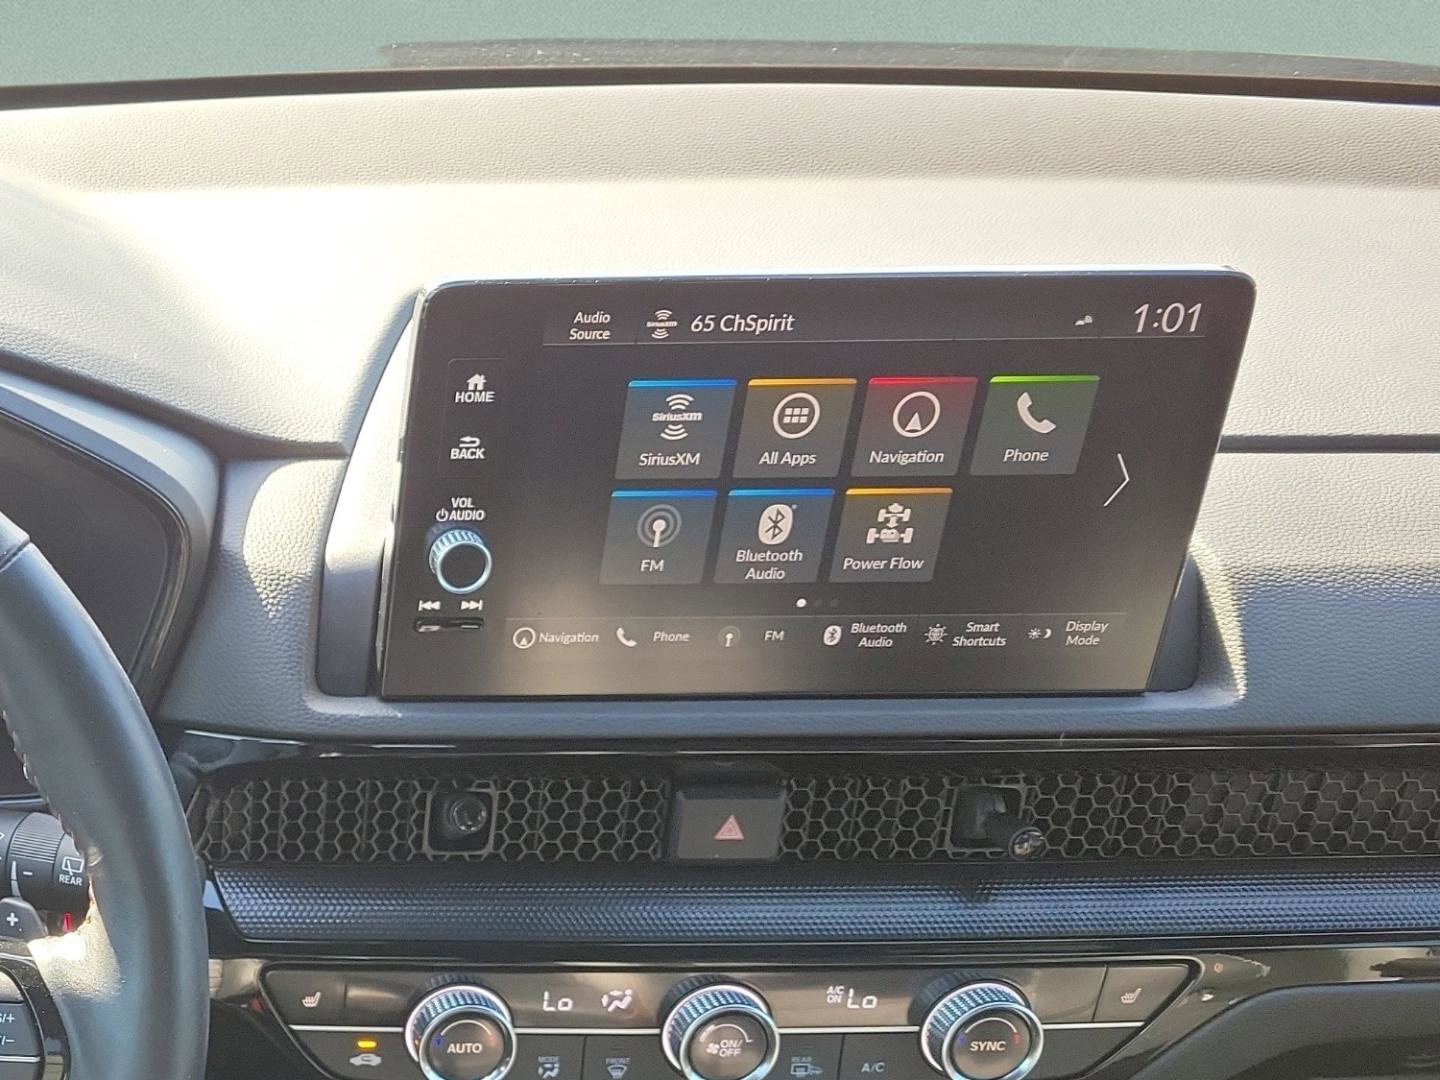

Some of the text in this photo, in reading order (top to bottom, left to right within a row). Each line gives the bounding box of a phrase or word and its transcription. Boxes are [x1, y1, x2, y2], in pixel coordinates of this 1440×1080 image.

[573, 311, 611, 325] Audio
[1133, 302, 1203, 333] 1:01
[690, 313, 796, 335] 65 ChSpirit
[569, 328, 611, 340] Source
[454, 391, 496, 403] HOME
[450, 448, 486, 460] BACK
[638, 452, 701, 466] SiriusXM
[758, 451, 817, 467] All Apps
[868, 450, 944, 466] Navigation
[1003, 448, 1049, 463] Phone
[450, 497, 476, 508] VOL
[448, 509, 486, 521] AUDIO
[735, 549, 803, 563] Bluetooth
[640, 559, 665, 572] FM
[842, 556, 925, 571] Power Flow
[744, 567, 786, 581] Audio
[850, 622, 908, 634] Bluetooth
[965, 621, 1001, 633] Smart
[1065, 620, 1109, 633] Display
[538, 631, 600, 645] Navigation
[652, 630, 691, 643] Phone
[764, 630, 786, 641] FM
[951, 635, 1007, 647] Shortcuts
[1065, 634, 1101, 646] Mode
[858, 636, 893, 648] Audio
[59, 874, 83, 887] REAR
[826, 985, 846, 994] A/C
[542, 990, 574, 1012] Lo
[826, 994, 842, 1004] ON
[847, 988, 878, 1009] Lo
[446, 1042, 482, 1054] AUTO
[720, 1039, 743, 1049] ON/
[969, 1040, 1007, 1051] SYNC
[718, 1048, 742, 1058] OFF
[861, 1062, 886, 1073] A/C
